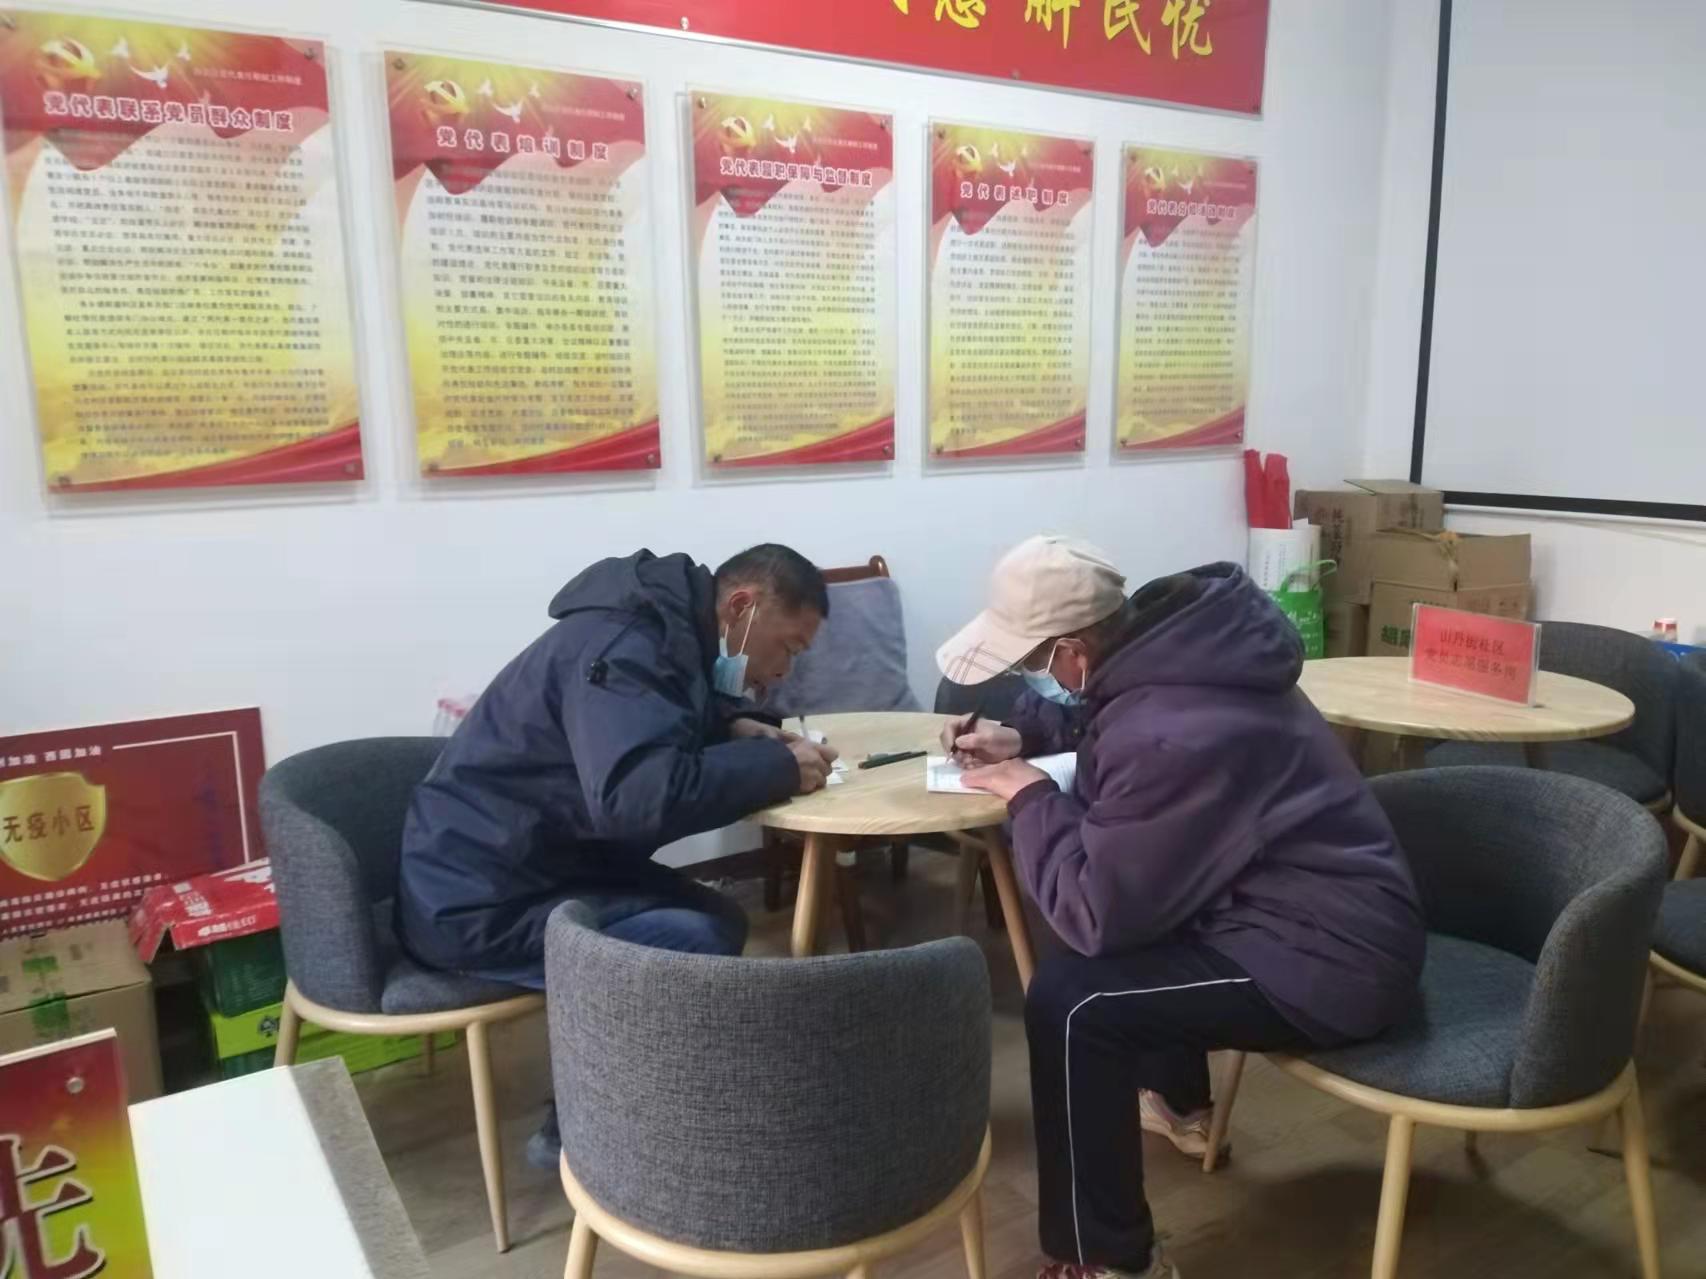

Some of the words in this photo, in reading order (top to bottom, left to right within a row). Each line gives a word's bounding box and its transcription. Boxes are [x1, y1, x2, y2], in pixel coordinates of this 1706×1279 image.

[43, 91, 294, 132] 党代表联系党员群众制度
[436, 126, 611, 161] 党代表培训制度
[719, 156, 873, 188] 党代表履职保障与监督制度
[959, 181, 1070, 206] 党代表述职制度
[2, 804, 95, 843] 无疫小区
